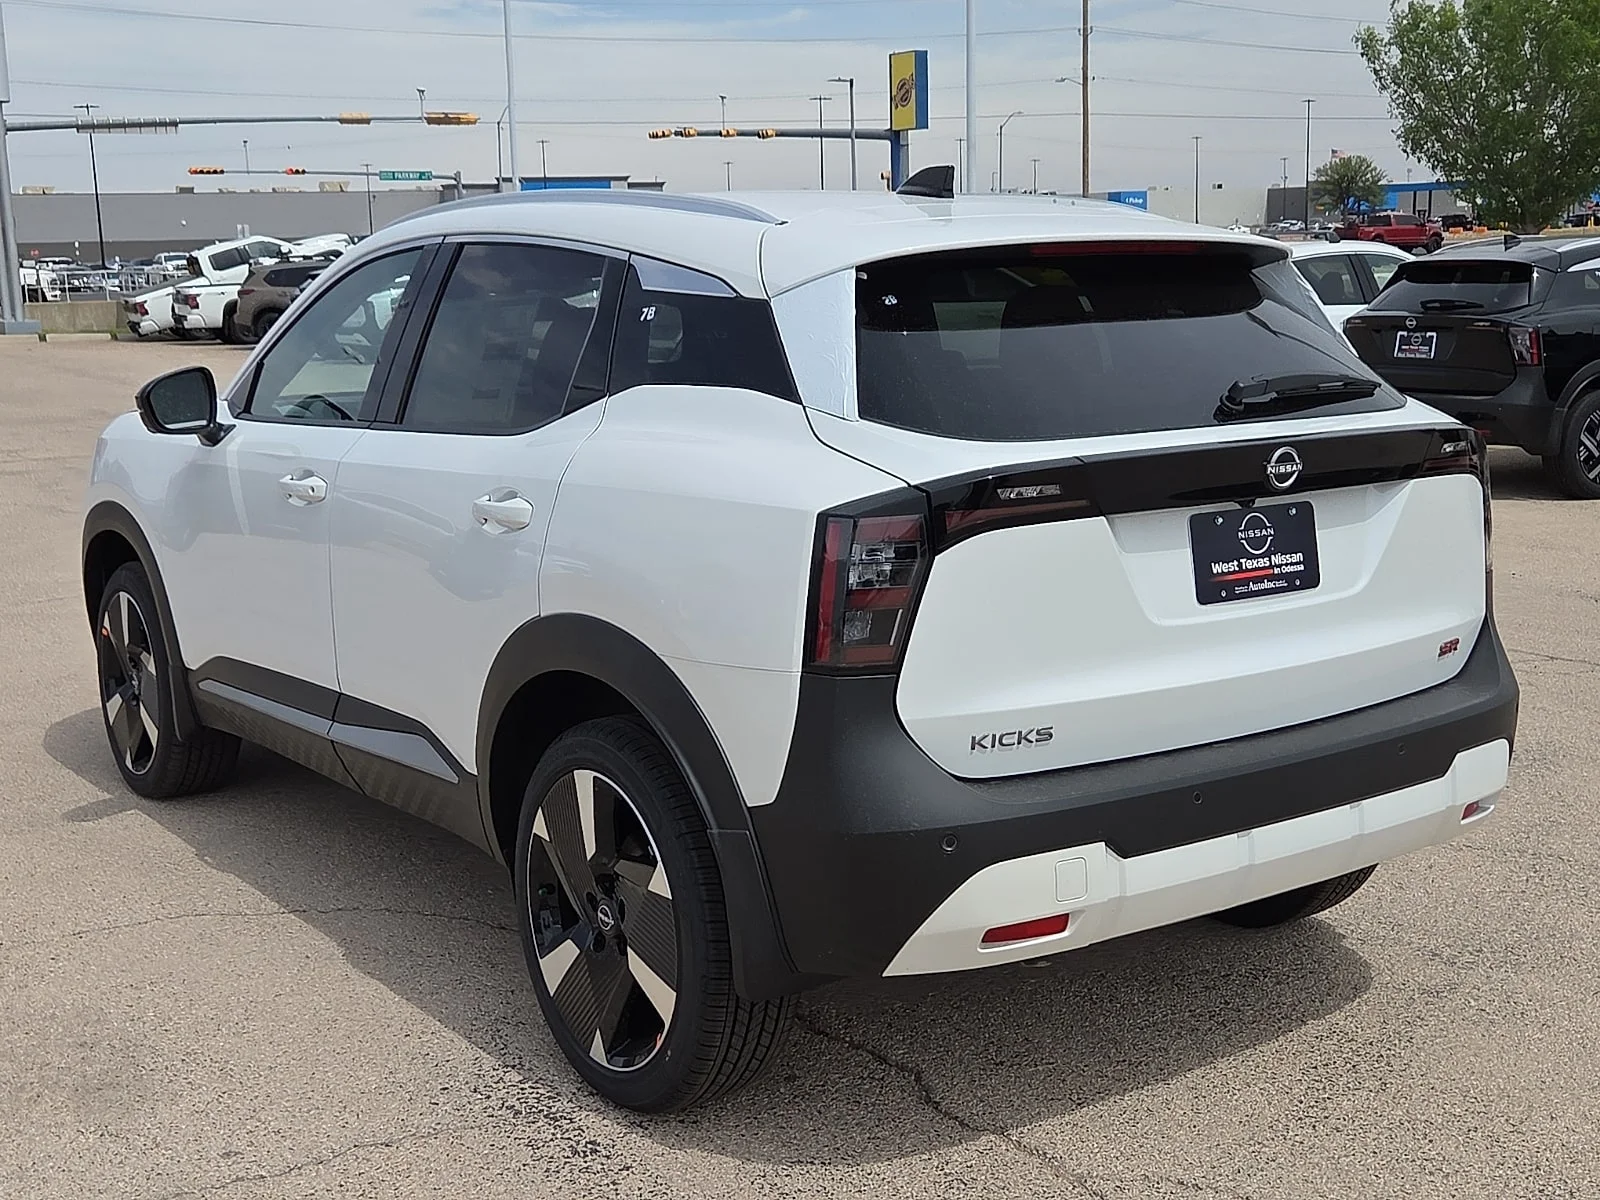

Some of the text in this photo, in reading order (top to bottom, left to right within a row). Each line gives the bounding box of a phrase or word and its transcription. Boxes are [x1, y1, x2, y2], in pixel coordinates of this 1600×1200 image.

[1267, 462, 1303, 474] NISSAN
[1238, 527, 1275, 540] NISSAN
[1211, 552, 1304, 574] West Texas Nissan
[1281, 564, 1305, 574] Odessa
[1249, 579, 1276, 592] AutoInc
[970, 726, 1054, 751] KICKS
